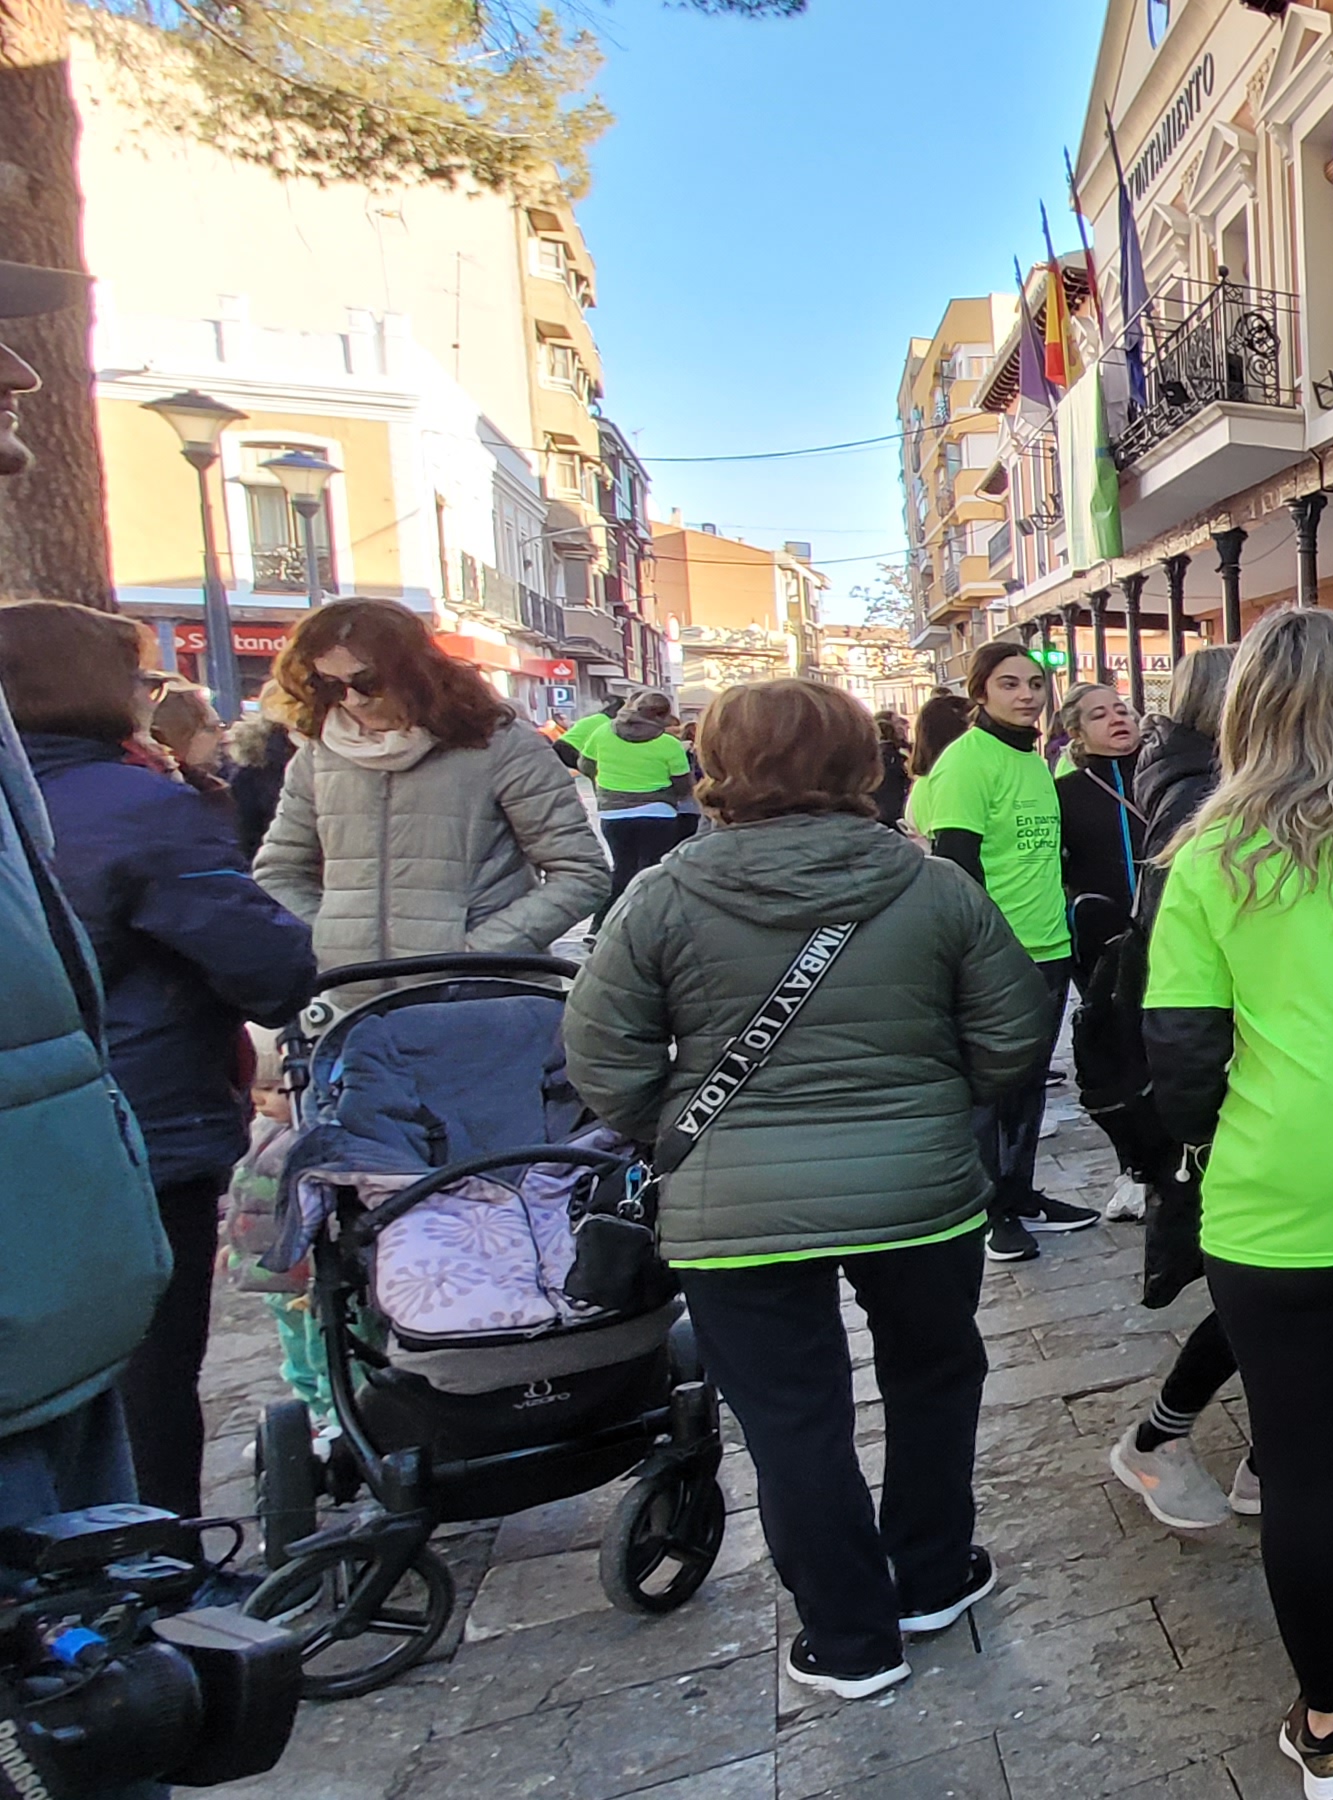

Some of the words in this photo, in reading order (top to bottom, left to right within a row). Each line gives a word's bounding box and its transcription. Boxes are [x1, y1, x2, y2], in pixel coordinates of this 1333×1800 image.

[1127, 52, 1214, 202] YUNTAMIENTO
[188, 633, 290, 651] Stand
[553, 687, 569, 707] P
[783, 921, 852, 990] IMBA
[773, 995, 802, 1014] Y
[729, 1052, 750, 1073] Y
[676, 1071, 740, 1135] LOLA
